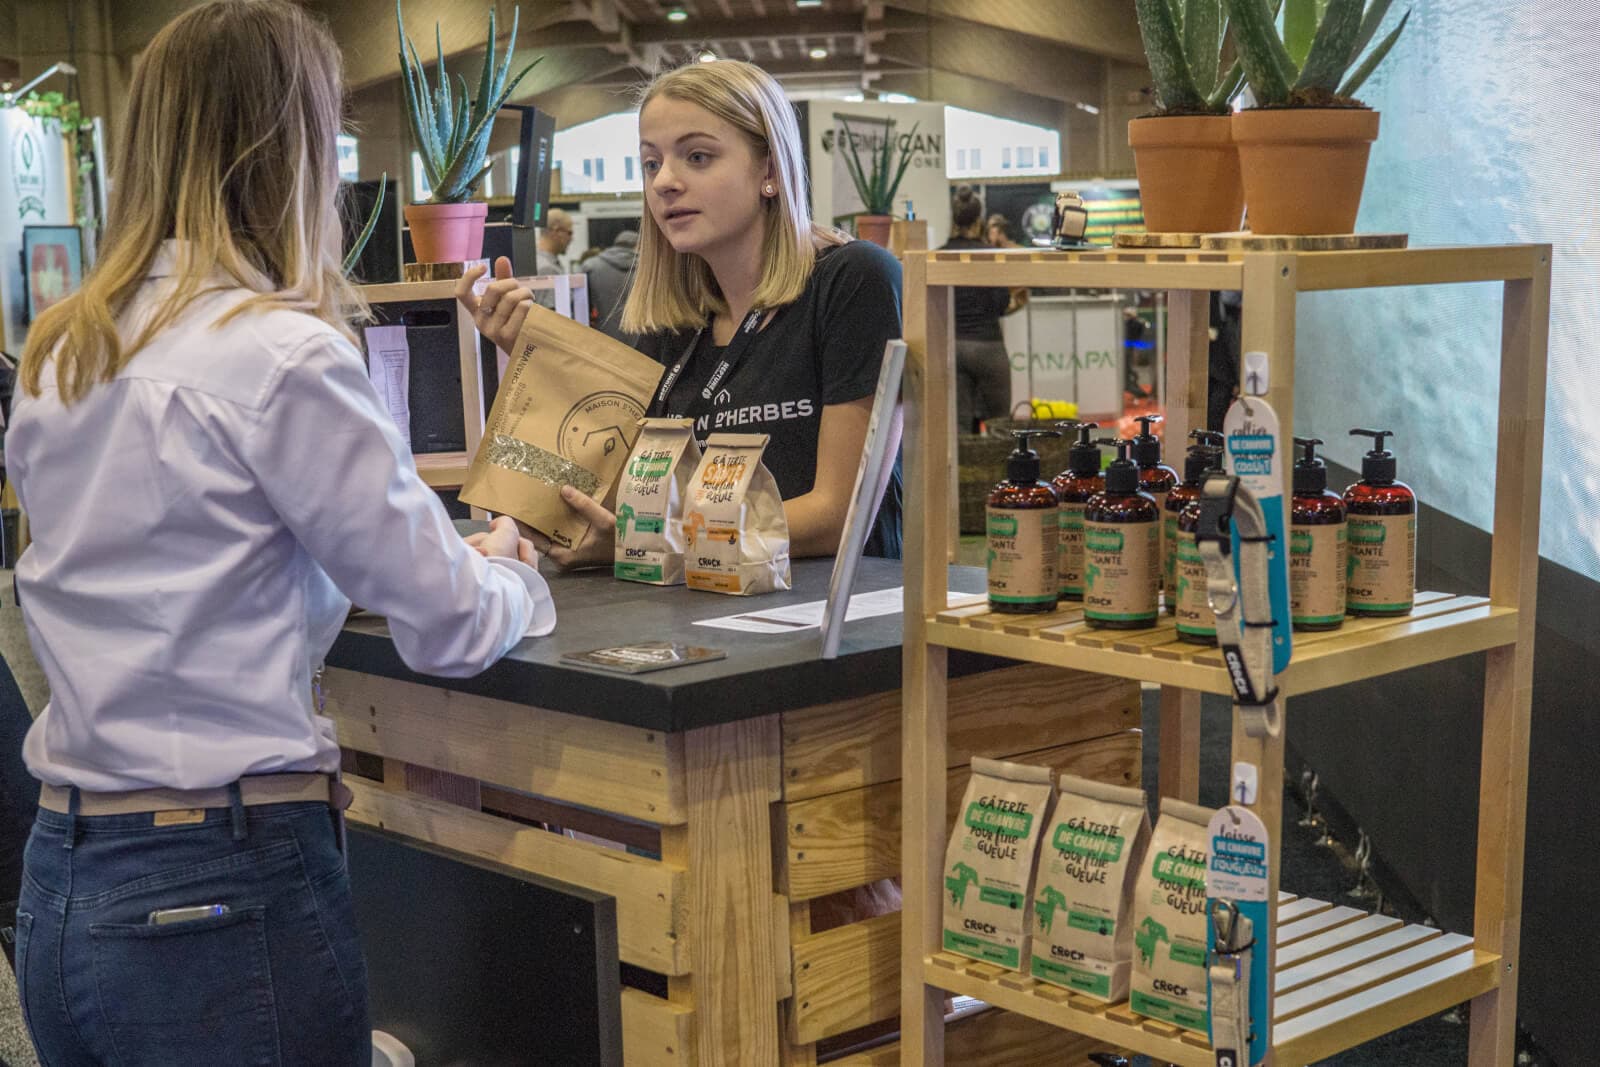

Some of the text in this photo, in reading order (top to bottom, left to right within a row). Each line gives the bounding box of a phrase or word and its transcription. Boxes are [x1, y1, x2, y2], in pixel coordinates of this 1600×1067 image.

[914, 157, 942, 169] ONE
[584, 399, 620, 414] MAISON
[714, 399, 814, 429] D'HERBES
[979, 795, 1028, 815] GÂTERIE
[970, 825, 993, 841] POUR
[1067, 817, 1119, 838] GÂTERIE
[977, 840, 1017, 860] GUEULE
[1058, 848, 1081, 865] POUR
[1065, 863, 1107, 884] GUEULE
[1159, 859, 1173, 875] DE
[1159, 878, 1184, 895] POUR
